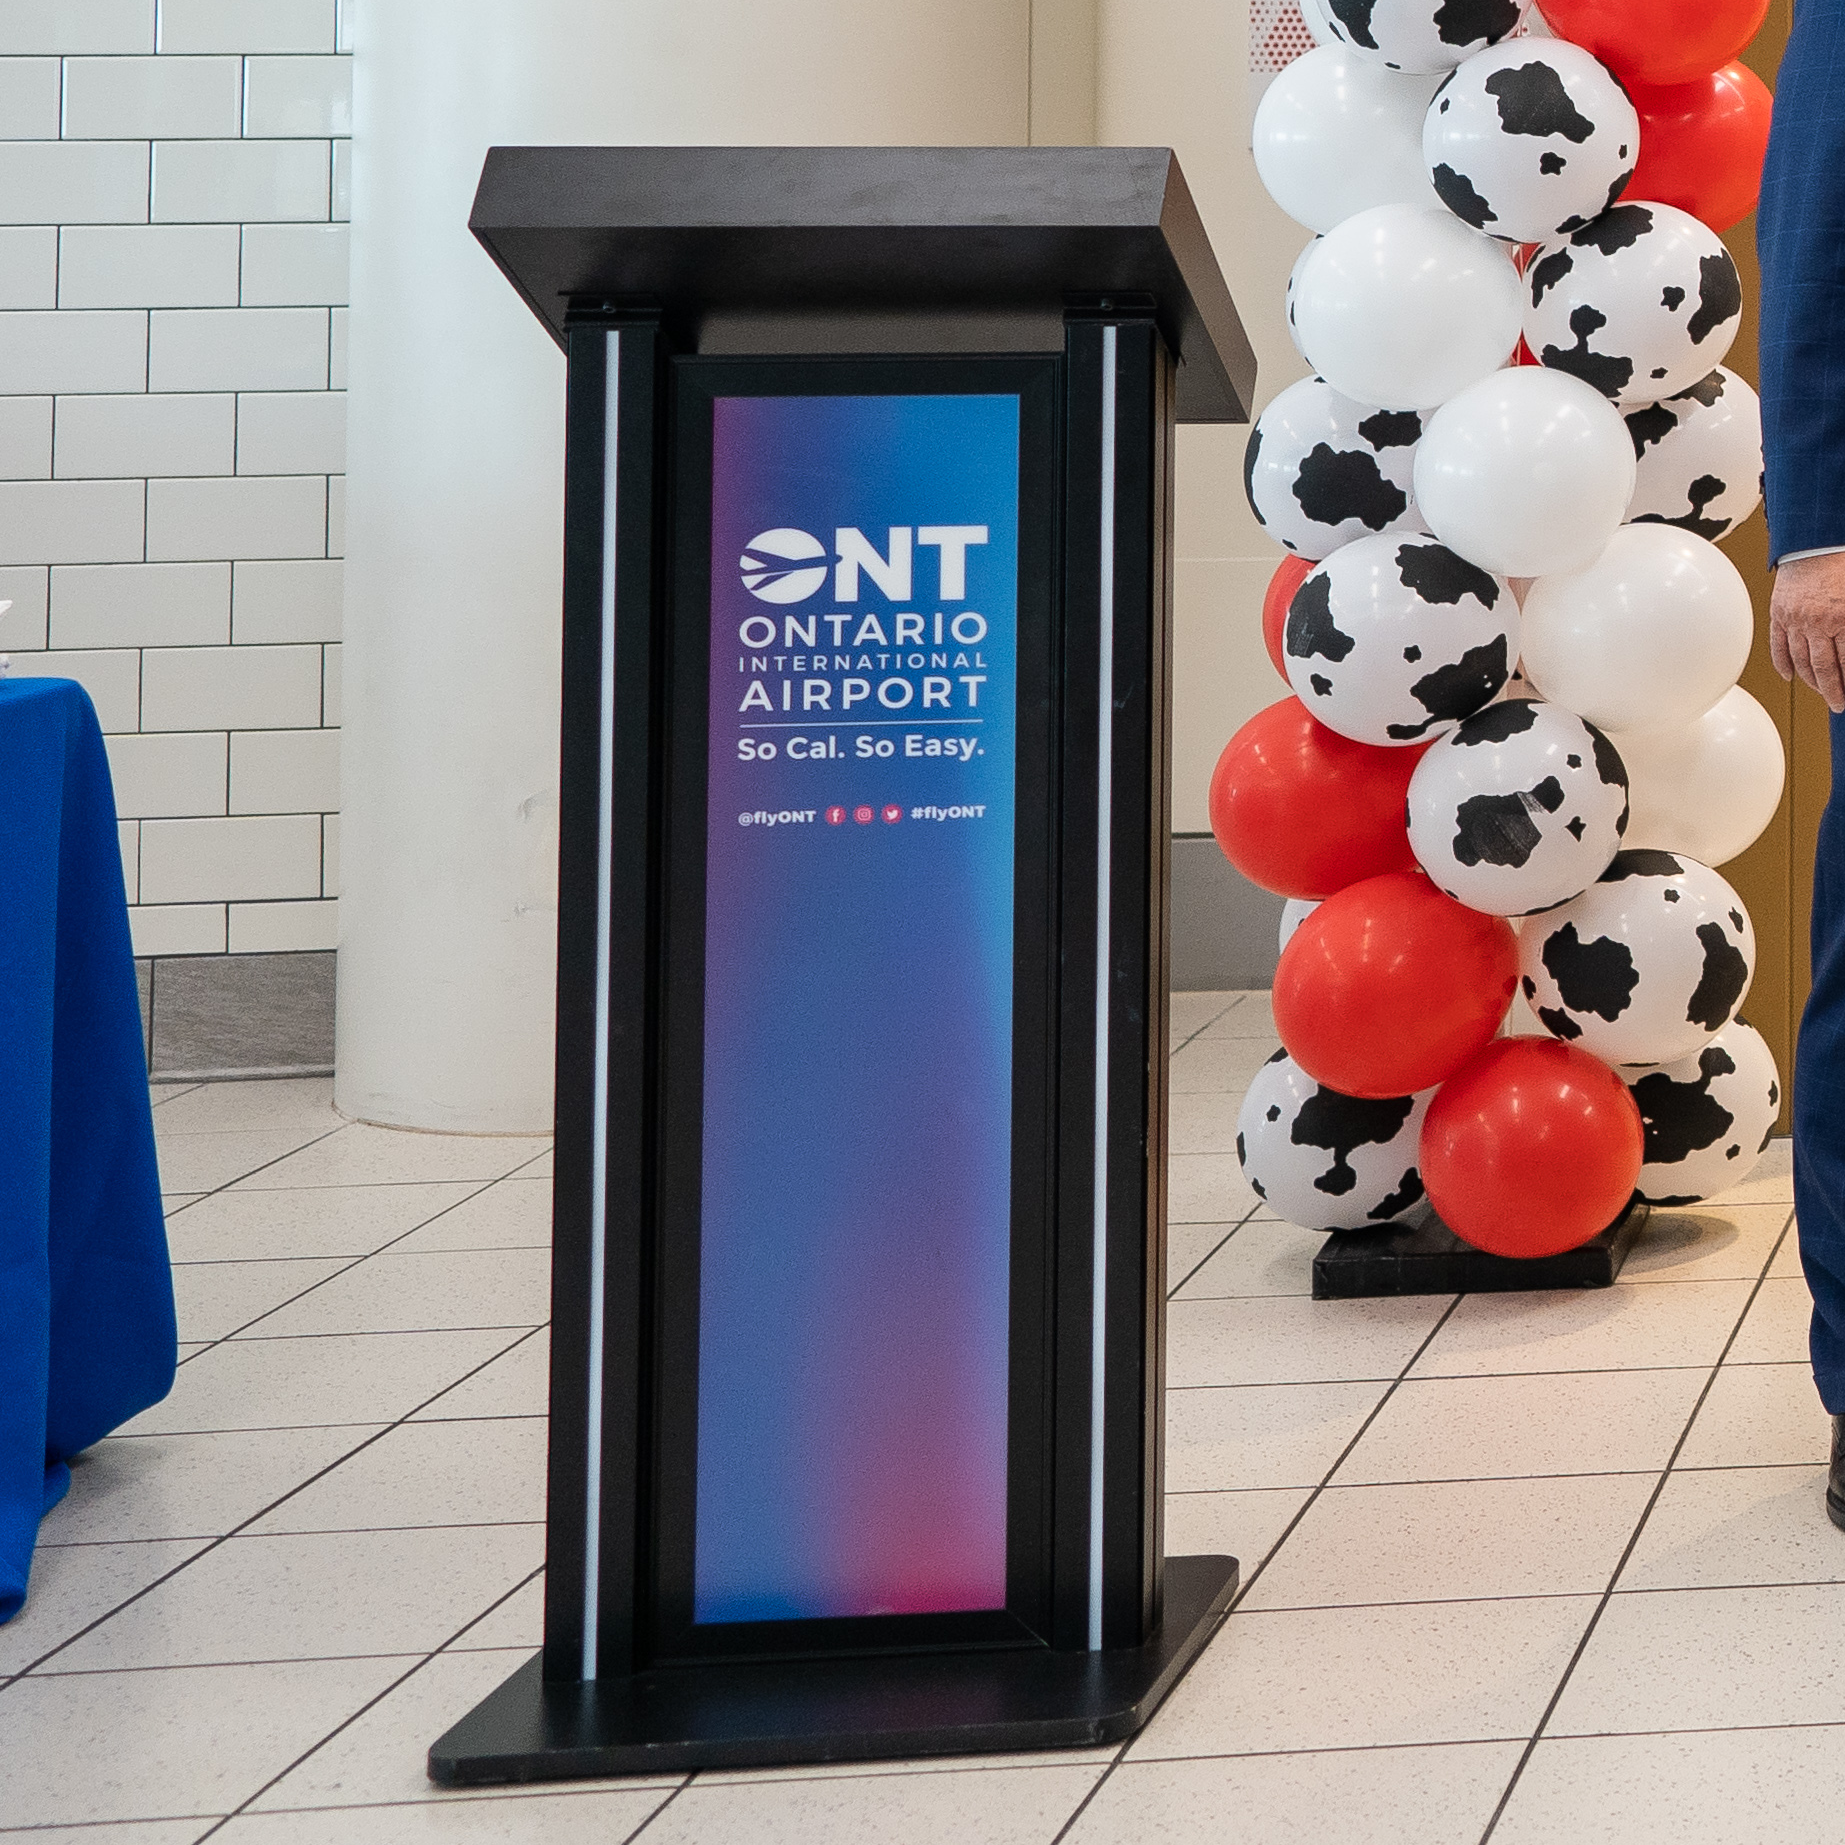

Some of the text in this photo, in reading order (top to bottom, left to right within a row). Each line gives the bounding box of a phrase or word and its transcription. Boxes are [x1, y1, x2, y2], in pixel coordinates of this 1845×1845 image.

[739, 525, 989, 605] ONT
[739, 612, 987, 649] ONTARIO
[739, 653, 987, 673] INTERNATIONAL
[739, 675, 987, 713] AIRPORT
[738, 734, 985, 762] So Cal. So Easy.
[738, 804, 986, 828] @flyONT #flyONT
